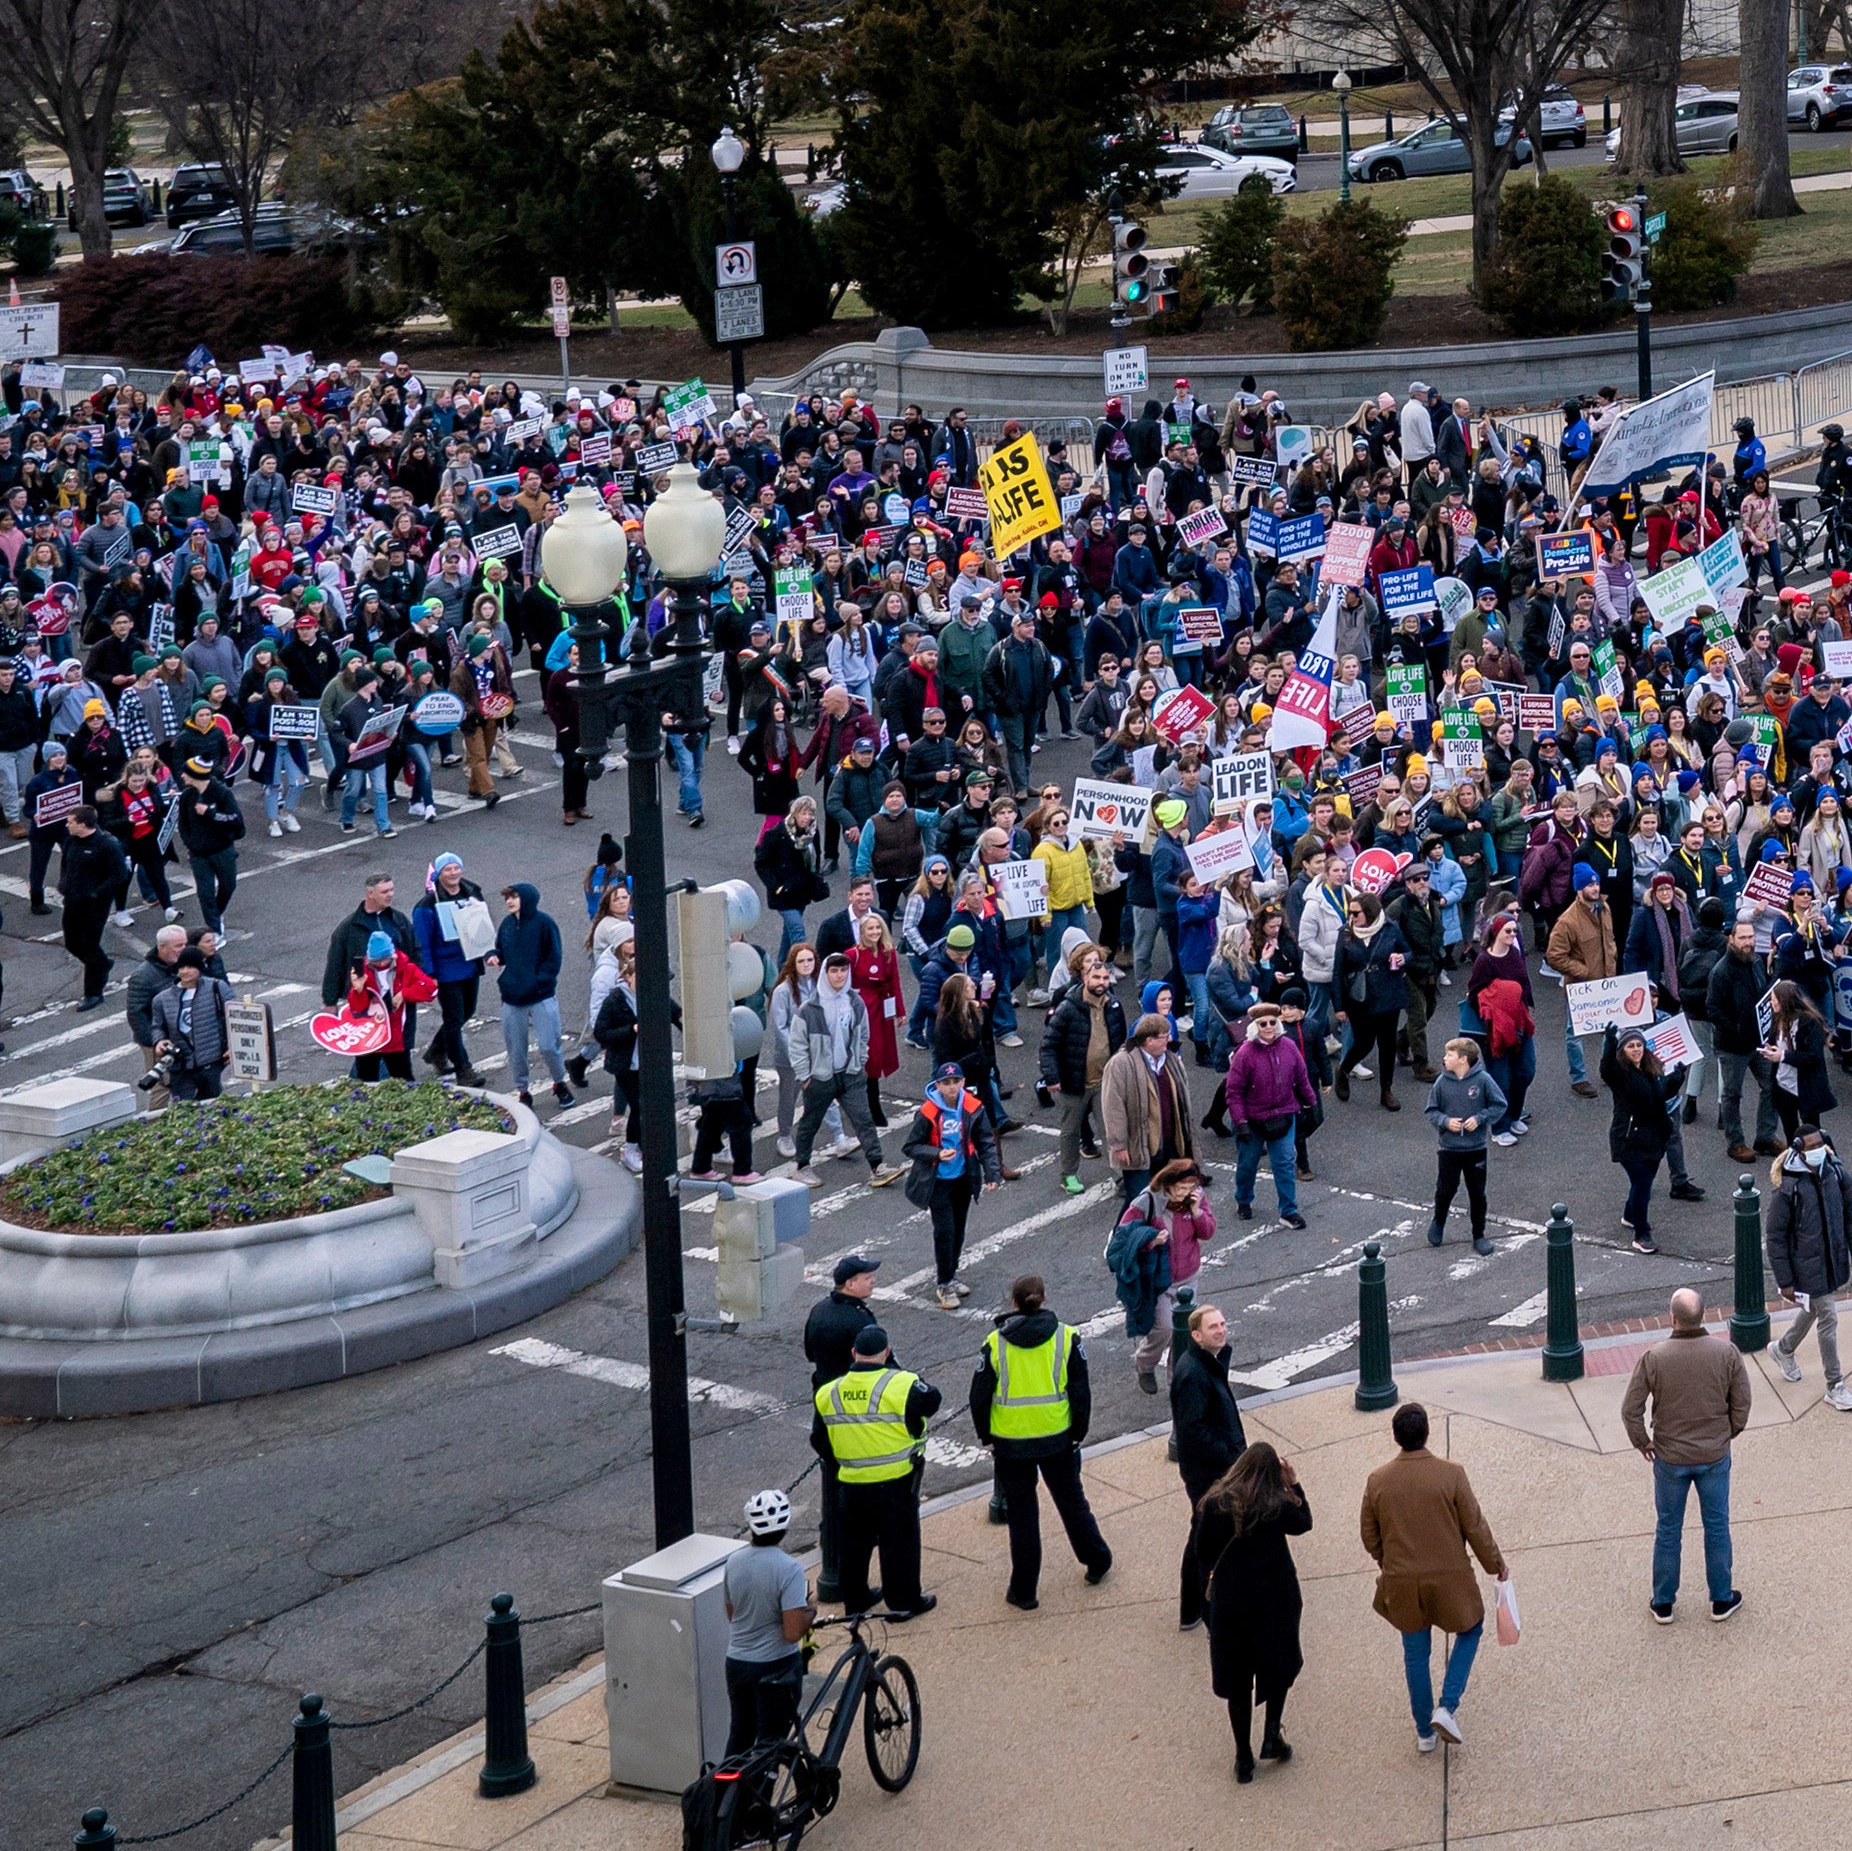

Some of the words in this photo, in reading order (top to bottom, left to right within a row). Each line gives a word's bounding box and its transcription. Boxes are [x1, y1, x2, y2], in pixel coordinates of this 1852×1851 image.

[721, 291, 735, 299] ONE
[738, 290, 757, 298] LANE
[8, 313, 44, 322] CHURCH
[1115, 362, 1138, 370] TURN
[1333, 524, 1370, 537] 32000
[1544, 545, 1590, 559] Democrat
[1326, 555, 1364, 567] SUPPORT
[1545, 553, 1590, 569] Pro-Life
[775, 569, 794, 582] LOVE
[795, 568, 811, 581] LIFE
[1383, 572, 1419, 585] PRO-LIFE
[1384, 586, 1401, 596] FOR
[1403, 583, 1419, 592] THE
[780, 596, 809, 607] CHOOSE
[1387, 593, 1415, 605] WHOLE
[1416, 589, 1433, 599] LIFE
[789, 607, 803, 618] LIFE
[1388, 669, 1407, 682] LOVE
[1408, 668, 1423, 681] LIFE
[1392, 694, 1422, 707] CHOOSE
[1398, 707, 1416, 721] LIFE
[1215, 760, 1246, 775] LEAD
[1246, 757, 1267, 769] ON
[1216, 771, 1268, 801] LIFE
[1076, 789, 1149, 806] PERSONHOOD
[1193, 850, 1214, 861] EVERY
[1216, 840, 1243, 853] PERSON
[1007, 865, 1028, 879] LIVE
[1028, 899, 1046, 913] LIFE
[1601, 978, 1618, 990] On
[229, 1010, 263, 1020] AUTHORIZED
[1575, 1009, 1601, 1027] your
[230, 1023, 262, 1034] PERSONNEL
[241, 1038, 255, 1047] ONLY
[241, 1066, 260, 1076] CHECK
[843, 1390, 867, 1401] POLICE
